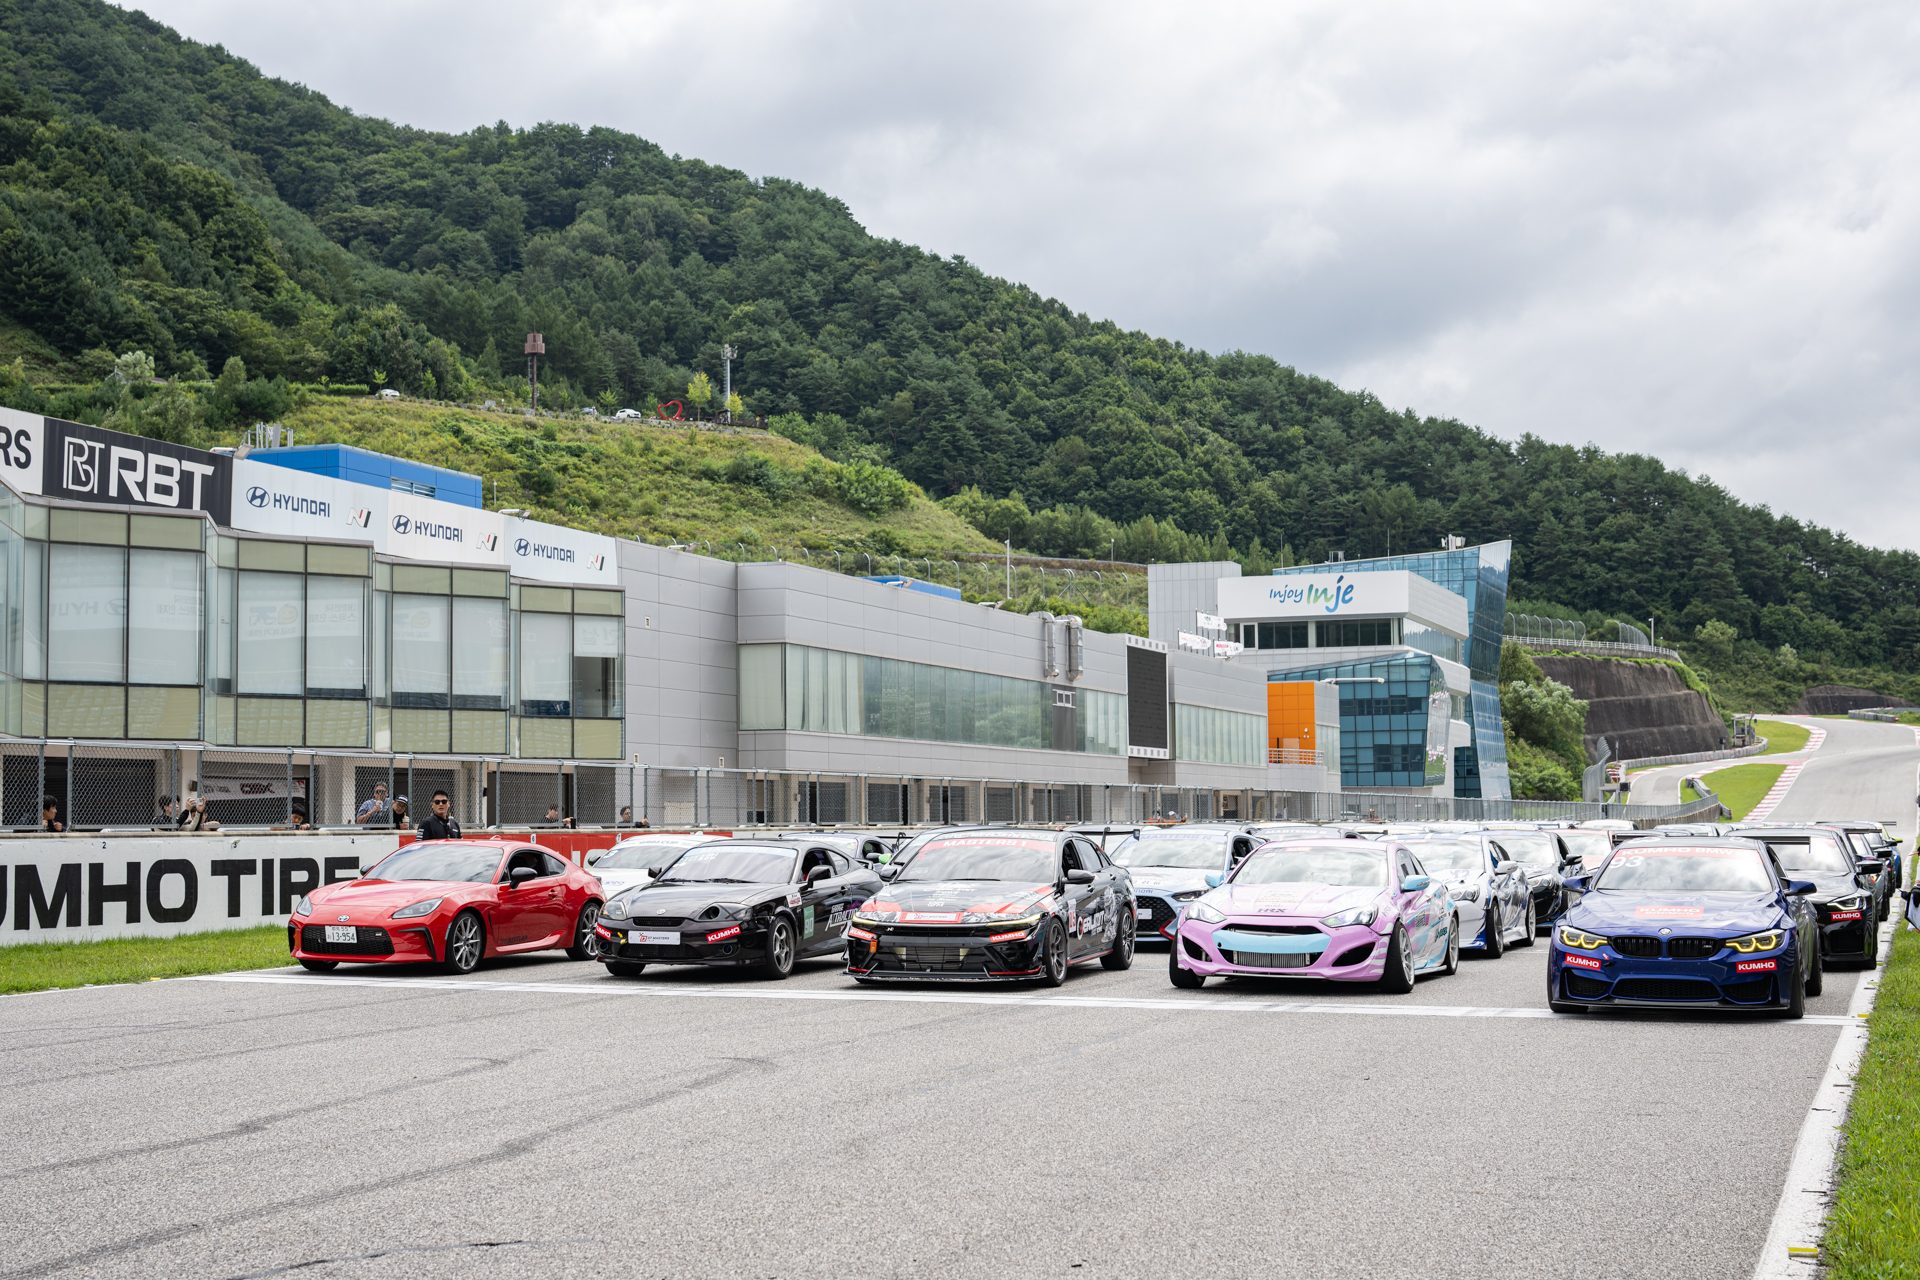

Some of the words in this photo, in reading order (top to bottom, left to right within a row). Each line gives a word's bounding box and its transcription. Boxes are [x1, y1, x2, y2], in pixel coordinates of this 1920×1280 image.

[109, 446, 214, 510] RBT
[273, 492, 330, 518] HYUNDAI
[414, 520, 463, 543] HYUNDAI
[533, 543, 575, 563] HYUNDAI
[1269, 585, 1303, 603] Injoy
[1307, 575, 1354, 613] Inje
[943, 839, 1017, 847] MASTERS
[1622, 847, 1690, 856] KUMHO
[1695, 847, 1735, 855] BMW
[1609, 856, 1645, 868] 93
[0, 859, 198, 931] MHO
[332, 932, 355, 941] 13-954
[708, 926, 740, 941] KUMHO
[851, 928, 872, 938] KUMHO
[992, 932, 1025, 941] KUMHO
[1566, 955, 1600, 968] KUMHO
[1738, 961, 1775, 971] KUMHO
